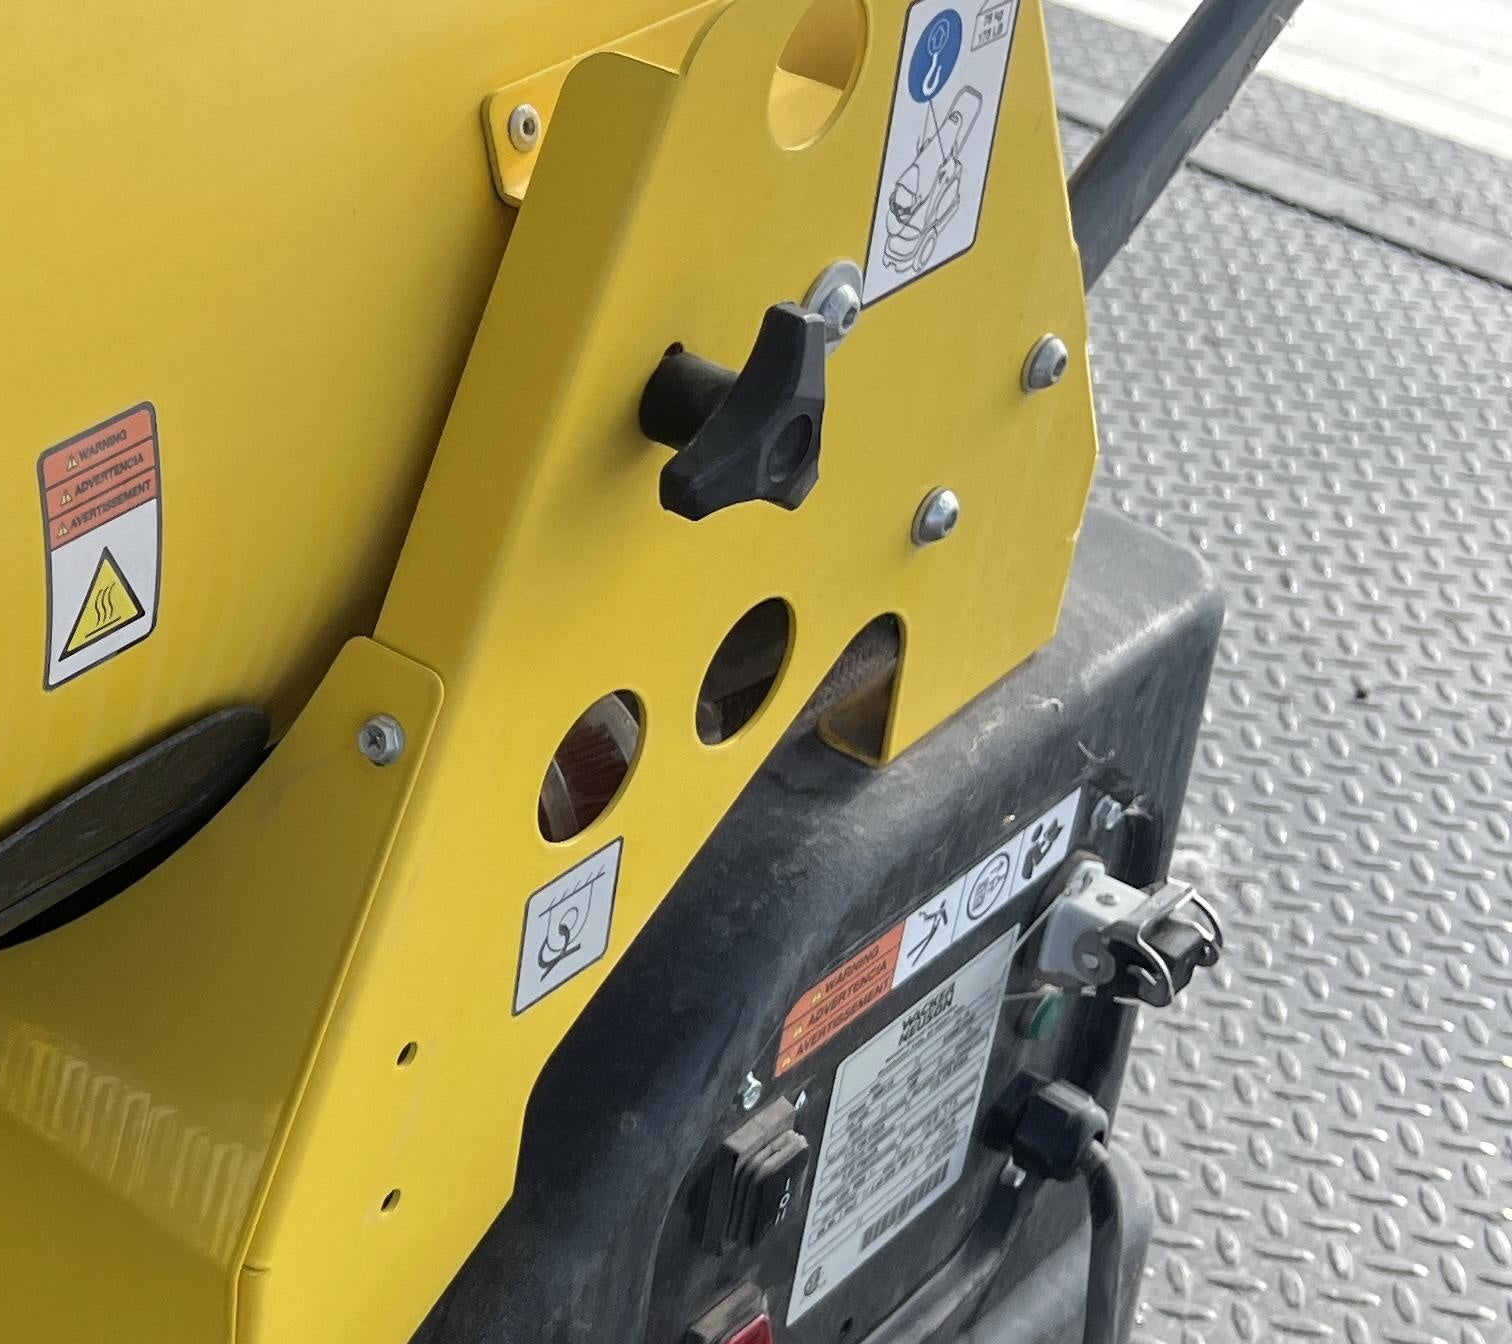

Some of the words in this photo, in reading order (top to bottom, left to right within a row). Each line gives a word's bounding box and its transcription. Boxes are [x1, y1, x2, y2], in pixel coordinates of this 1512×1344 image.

[78, 429, 128, 463] WARNING
[74, 453, 145, 498] ADVERTENCIA
[69, 478, 152, 531] AVERTISSEMENT
[807, 959, 888, 1029] ADVERTENCIA
[824, 945, 880, 994] WARNING
[795, 977, 890, 1056] AVERTISSEMENT
